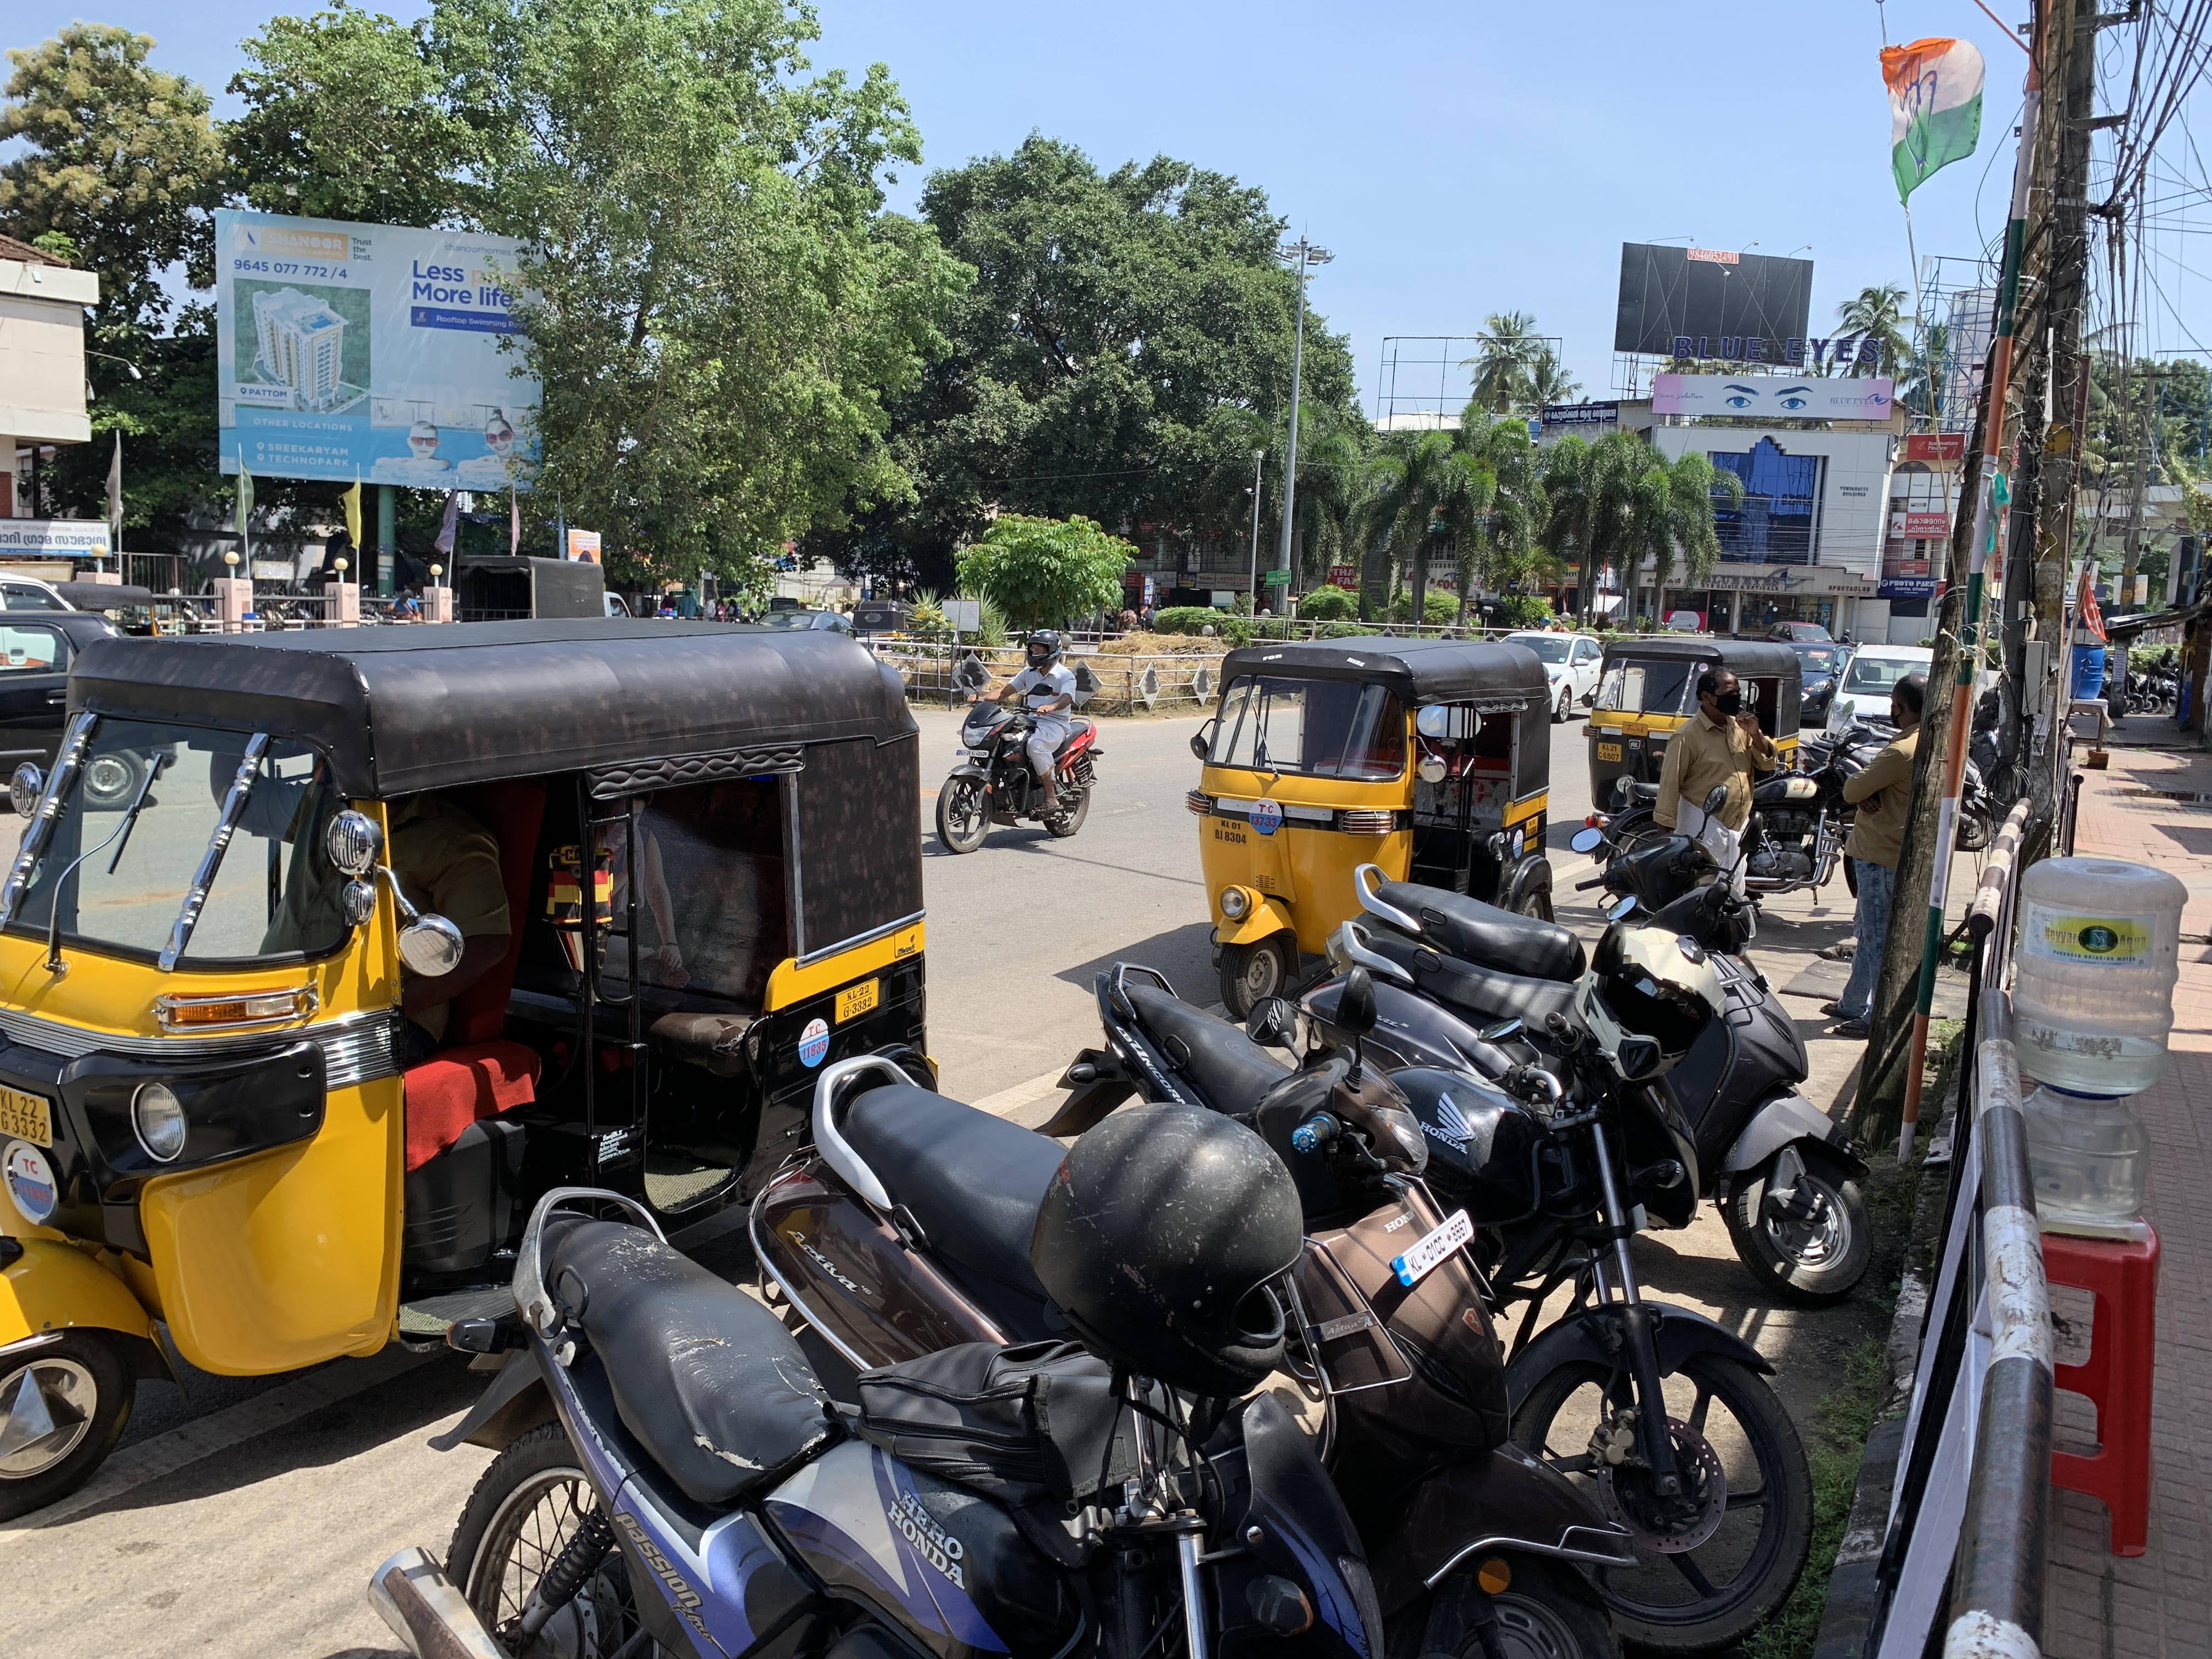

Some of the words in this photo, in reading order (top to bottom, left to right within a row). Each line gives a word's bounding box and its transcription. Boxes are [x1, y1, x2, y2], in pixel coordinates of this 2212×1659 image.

[268, 233, 343, 251] SHANOOR
[352, 238, 373, 246] Trust
[353, 253, 374, 261] best.
[234, 259, 269, 272] 9645
[274, 262, 299, 274] 077
[303, 265, 328, 278] 772
[413, 259, 465, 283] Less
[413, 281, 473, 304] More
[479, 286, 515, 307] life
[436, 314, 467, 325] Rooftop
[469, 318, 507, 329] Swimming
[1672, 336, 1764, 362] BLUE
[1784, 337, 1880, 364] EYES
[249, 388, 287, 398] PATTOM
[253, 417, 289, 427] OTHER
[292, 420, 353, 432] LOCATIONS
[267, 442, 349, 456] SREEKARYAM
[267, 454, 349, 467] TECHNOPARK
[24, 534, 52, 546] ഗ്രാമ
[1346, 657, 1365, 668] HIRE
[1626, 724, 1645, 733] Taxi
[1221, 820, 1230, 828] KL
[1232, 821, 1241, 830] 01
[1215, 829, 1223, 840] BJ
[1224, 830, 1247, 845] 8304
[2045, 926, 2079, 945] Neyyar
[2119, 934, 2147, 952] Aqua
[803, 1040, 827, 1060] 11835
[0, 1089, 16, 1113] KL
[20, 1096, 38, 1119] 22
[1, 1110, 8, 1130] G
[12, 1114, 47, 1143] 3332
[1419, 1121, 1468, 1155] HONDA
[22, 1158, 39, 1175] TC
[786, 1230, 858, 1293] Activa
[861, 1285, 873, 1295] 4G
[1408, 1255, 1423, 1275] KL
[899, 1488, 963, 1560] HERO
[887, 1500, 966, 1590] HONDA
